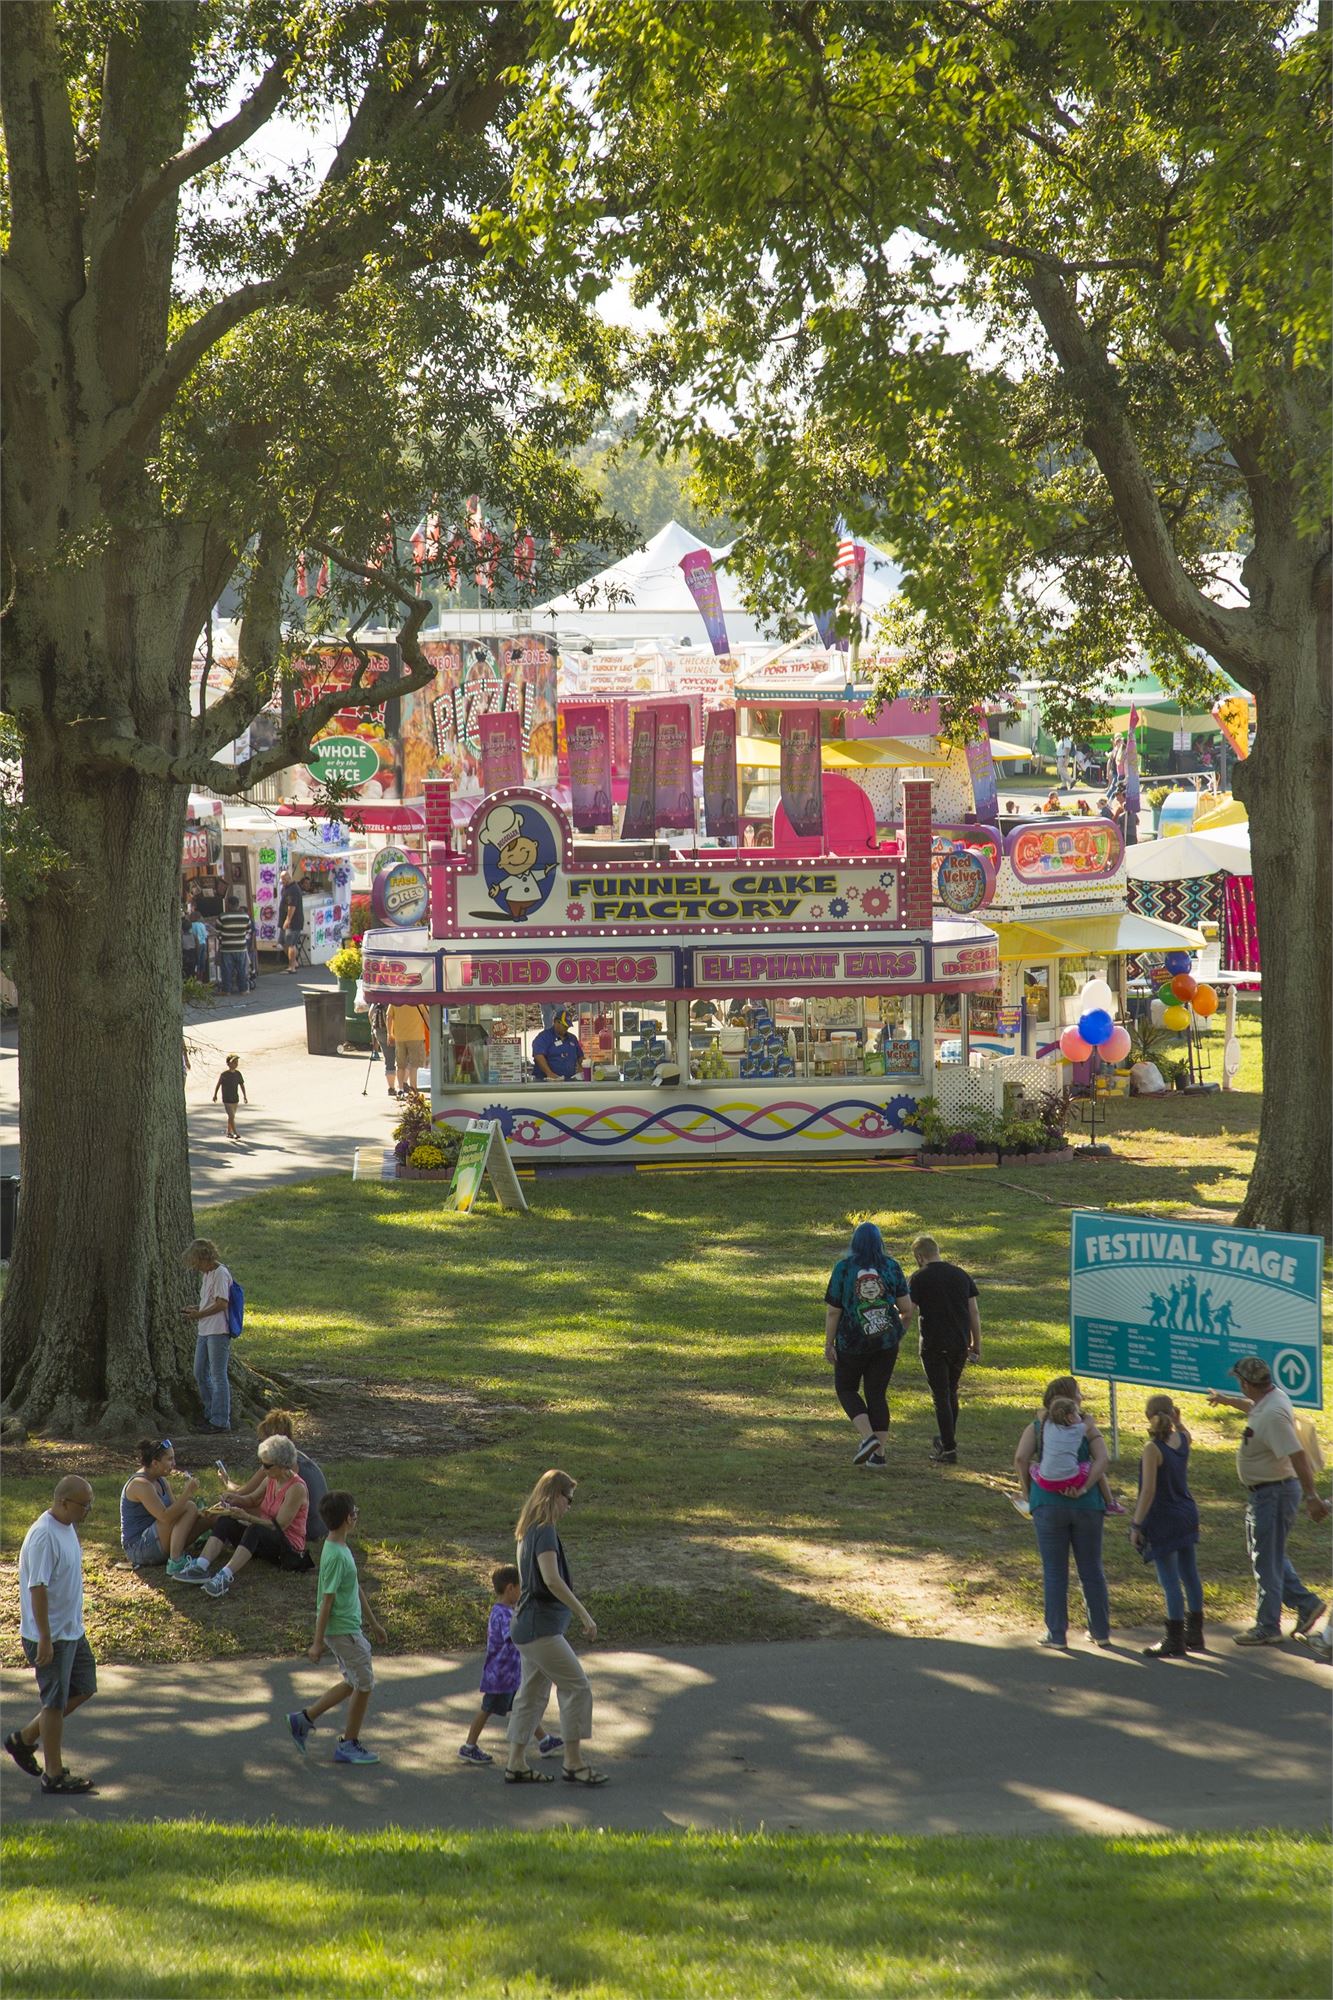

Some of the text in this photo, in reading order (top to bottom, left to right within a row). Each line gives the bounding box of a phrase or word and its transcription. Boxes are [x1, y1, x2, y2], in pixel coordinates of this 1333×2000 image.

[680, 657, 718, 665] CHICKEN
[685, 666, 713, 674] WINGS
[763, 662, 810, 675] PORK TIPS
[318, 745, 367, 758] WHOLE
[336, 759, 346, 767] by
[324, 769, 361, 781] SLICE
[949, 854, 971, 868] Red
[389, 874, 418, 888] Fried
[942, 869, 982, 883] Velvet
[569, 874, 839, 898] FUNNEL CAKE
[386, 887, 425, 909] OREO
[591, 898, 803, 921] FACTORY
[957, 947, 998, 962] COL
[364, 958, 407, 973] COLD
[460, 956, 659, 987] FRIED OREOS
[701, 951, 918, 982] ELEPHANT EARS
[942, 960, 998, 976] DRIN
[363, 971, 423, 986] RINKS
[892, 1042, 910, 1050] Red
[886, 1050, 917, 1058] Velvet
[1085, 1232, 1298, 1284] FESTIVAL STAGE
